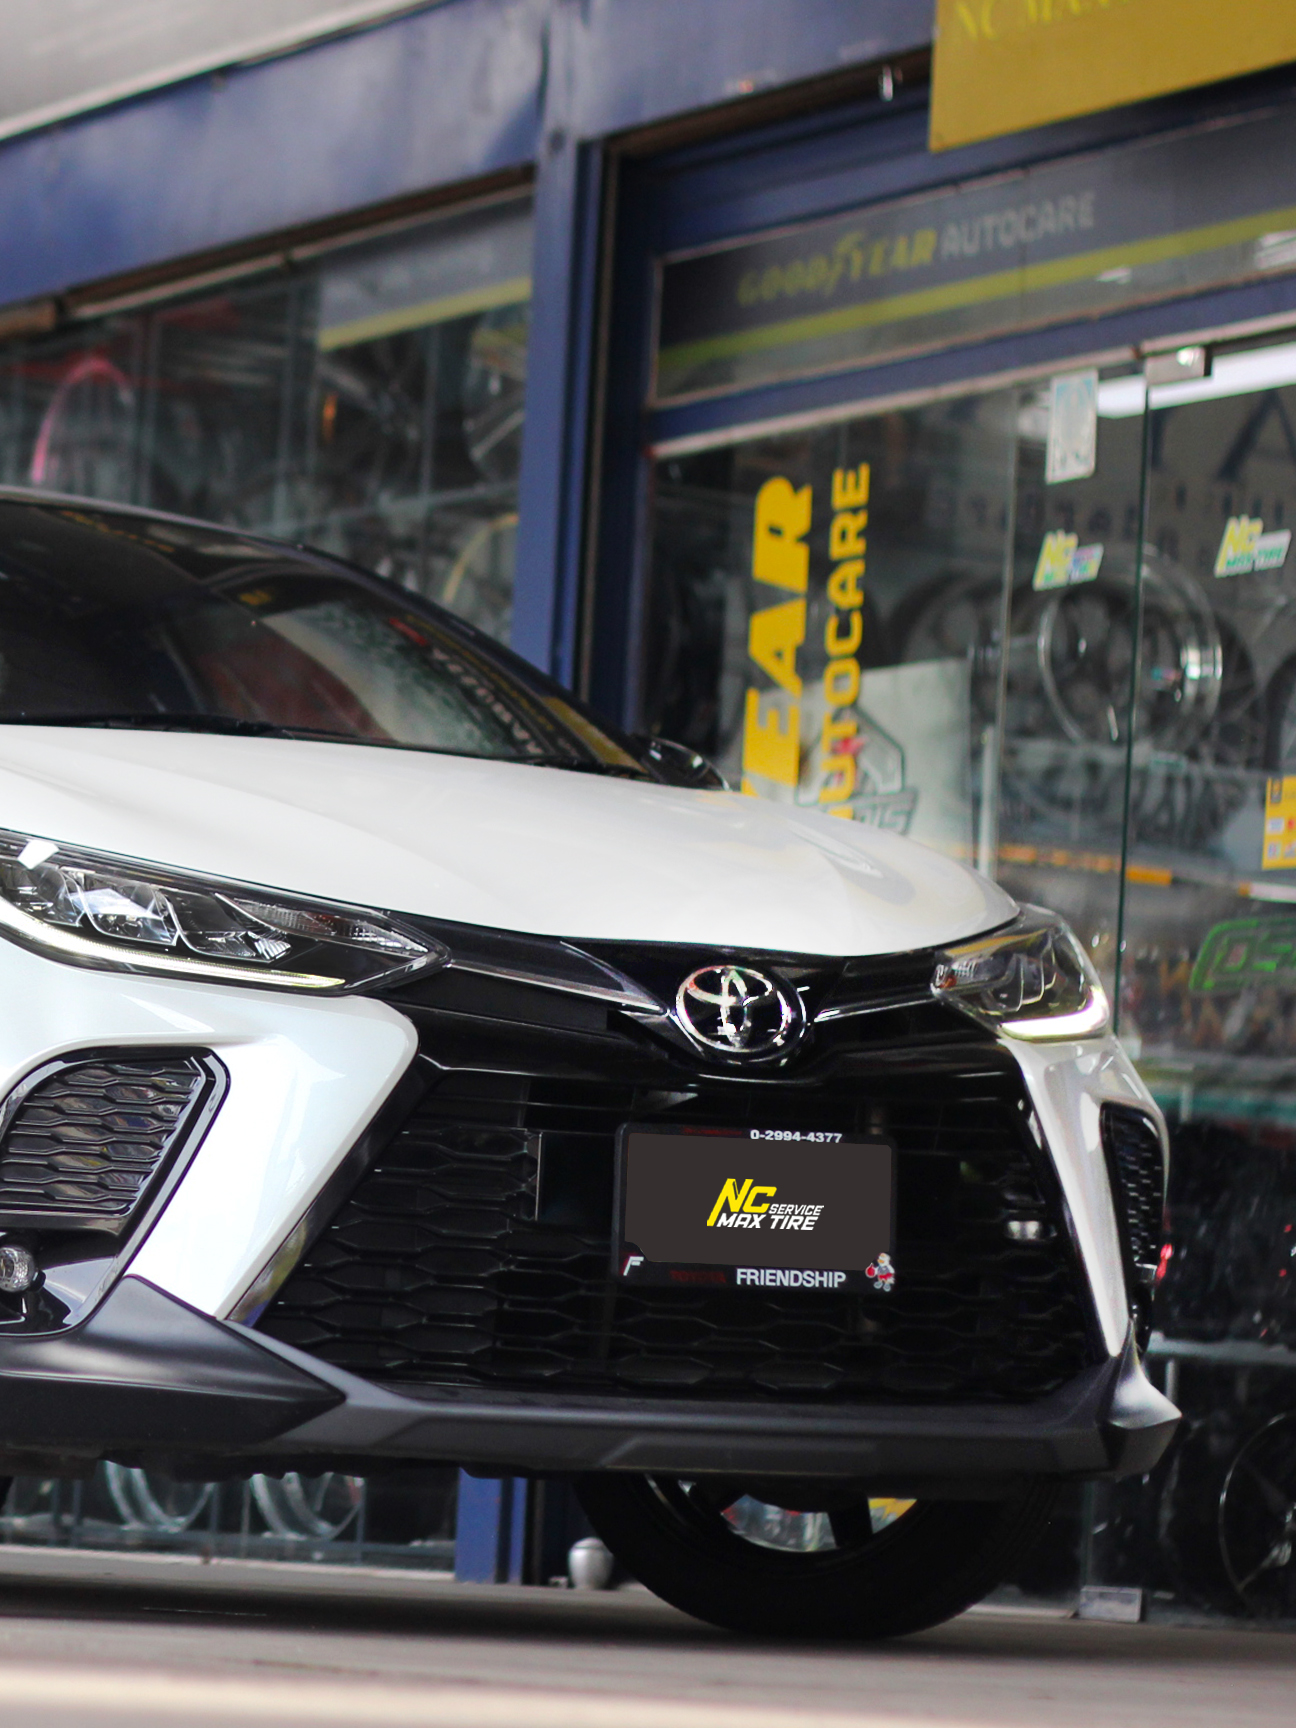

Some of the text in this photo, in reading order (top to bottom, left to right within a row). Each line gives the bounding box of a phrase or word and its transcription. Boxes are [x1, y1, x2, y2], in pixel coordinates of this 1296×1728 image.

[940, 191, 1095, 258] AUTOCARE
[741, 475, 813, 799] EAR
[749, 1129, 843, 1144] 0-2994-4377
[736, 1267, 847, 1288] FRIENDSHIP
